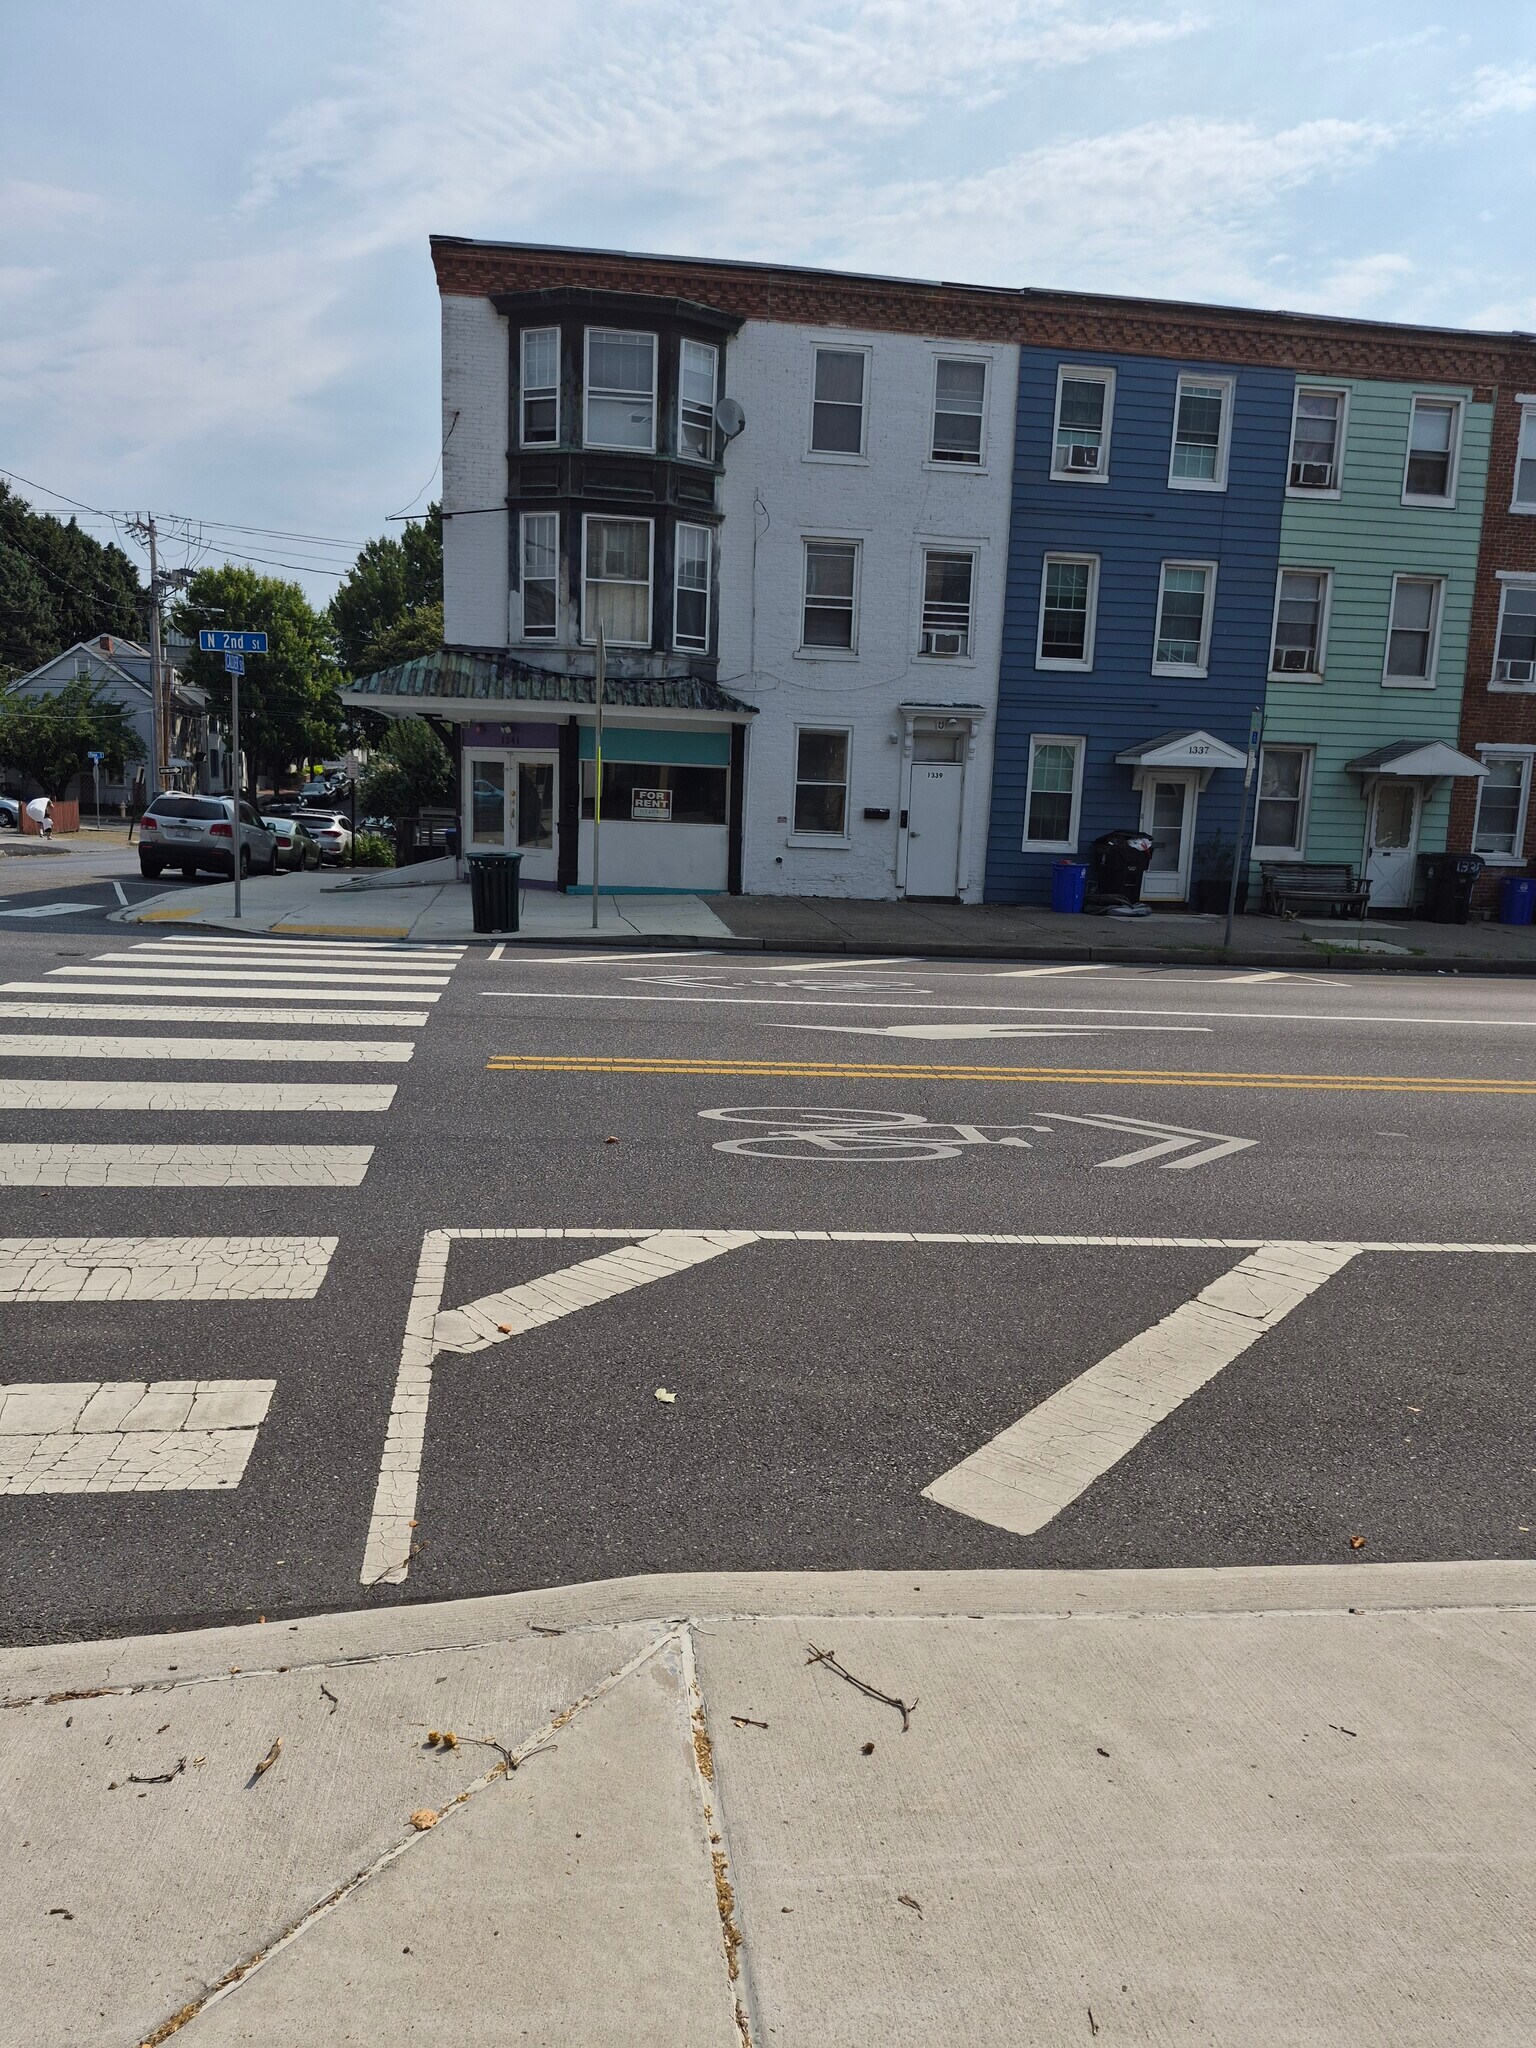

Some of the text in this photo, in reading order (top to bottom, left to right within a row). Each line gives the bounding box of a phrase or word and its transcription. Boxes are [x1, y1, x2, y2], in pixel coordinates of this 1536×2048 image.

[207, 633, 260, 650] N 2nd St
[1189, 746, 1209, 754] 1337
[639, 791, 665, 800] FOR
[635, 799, 669, 808] RENT
